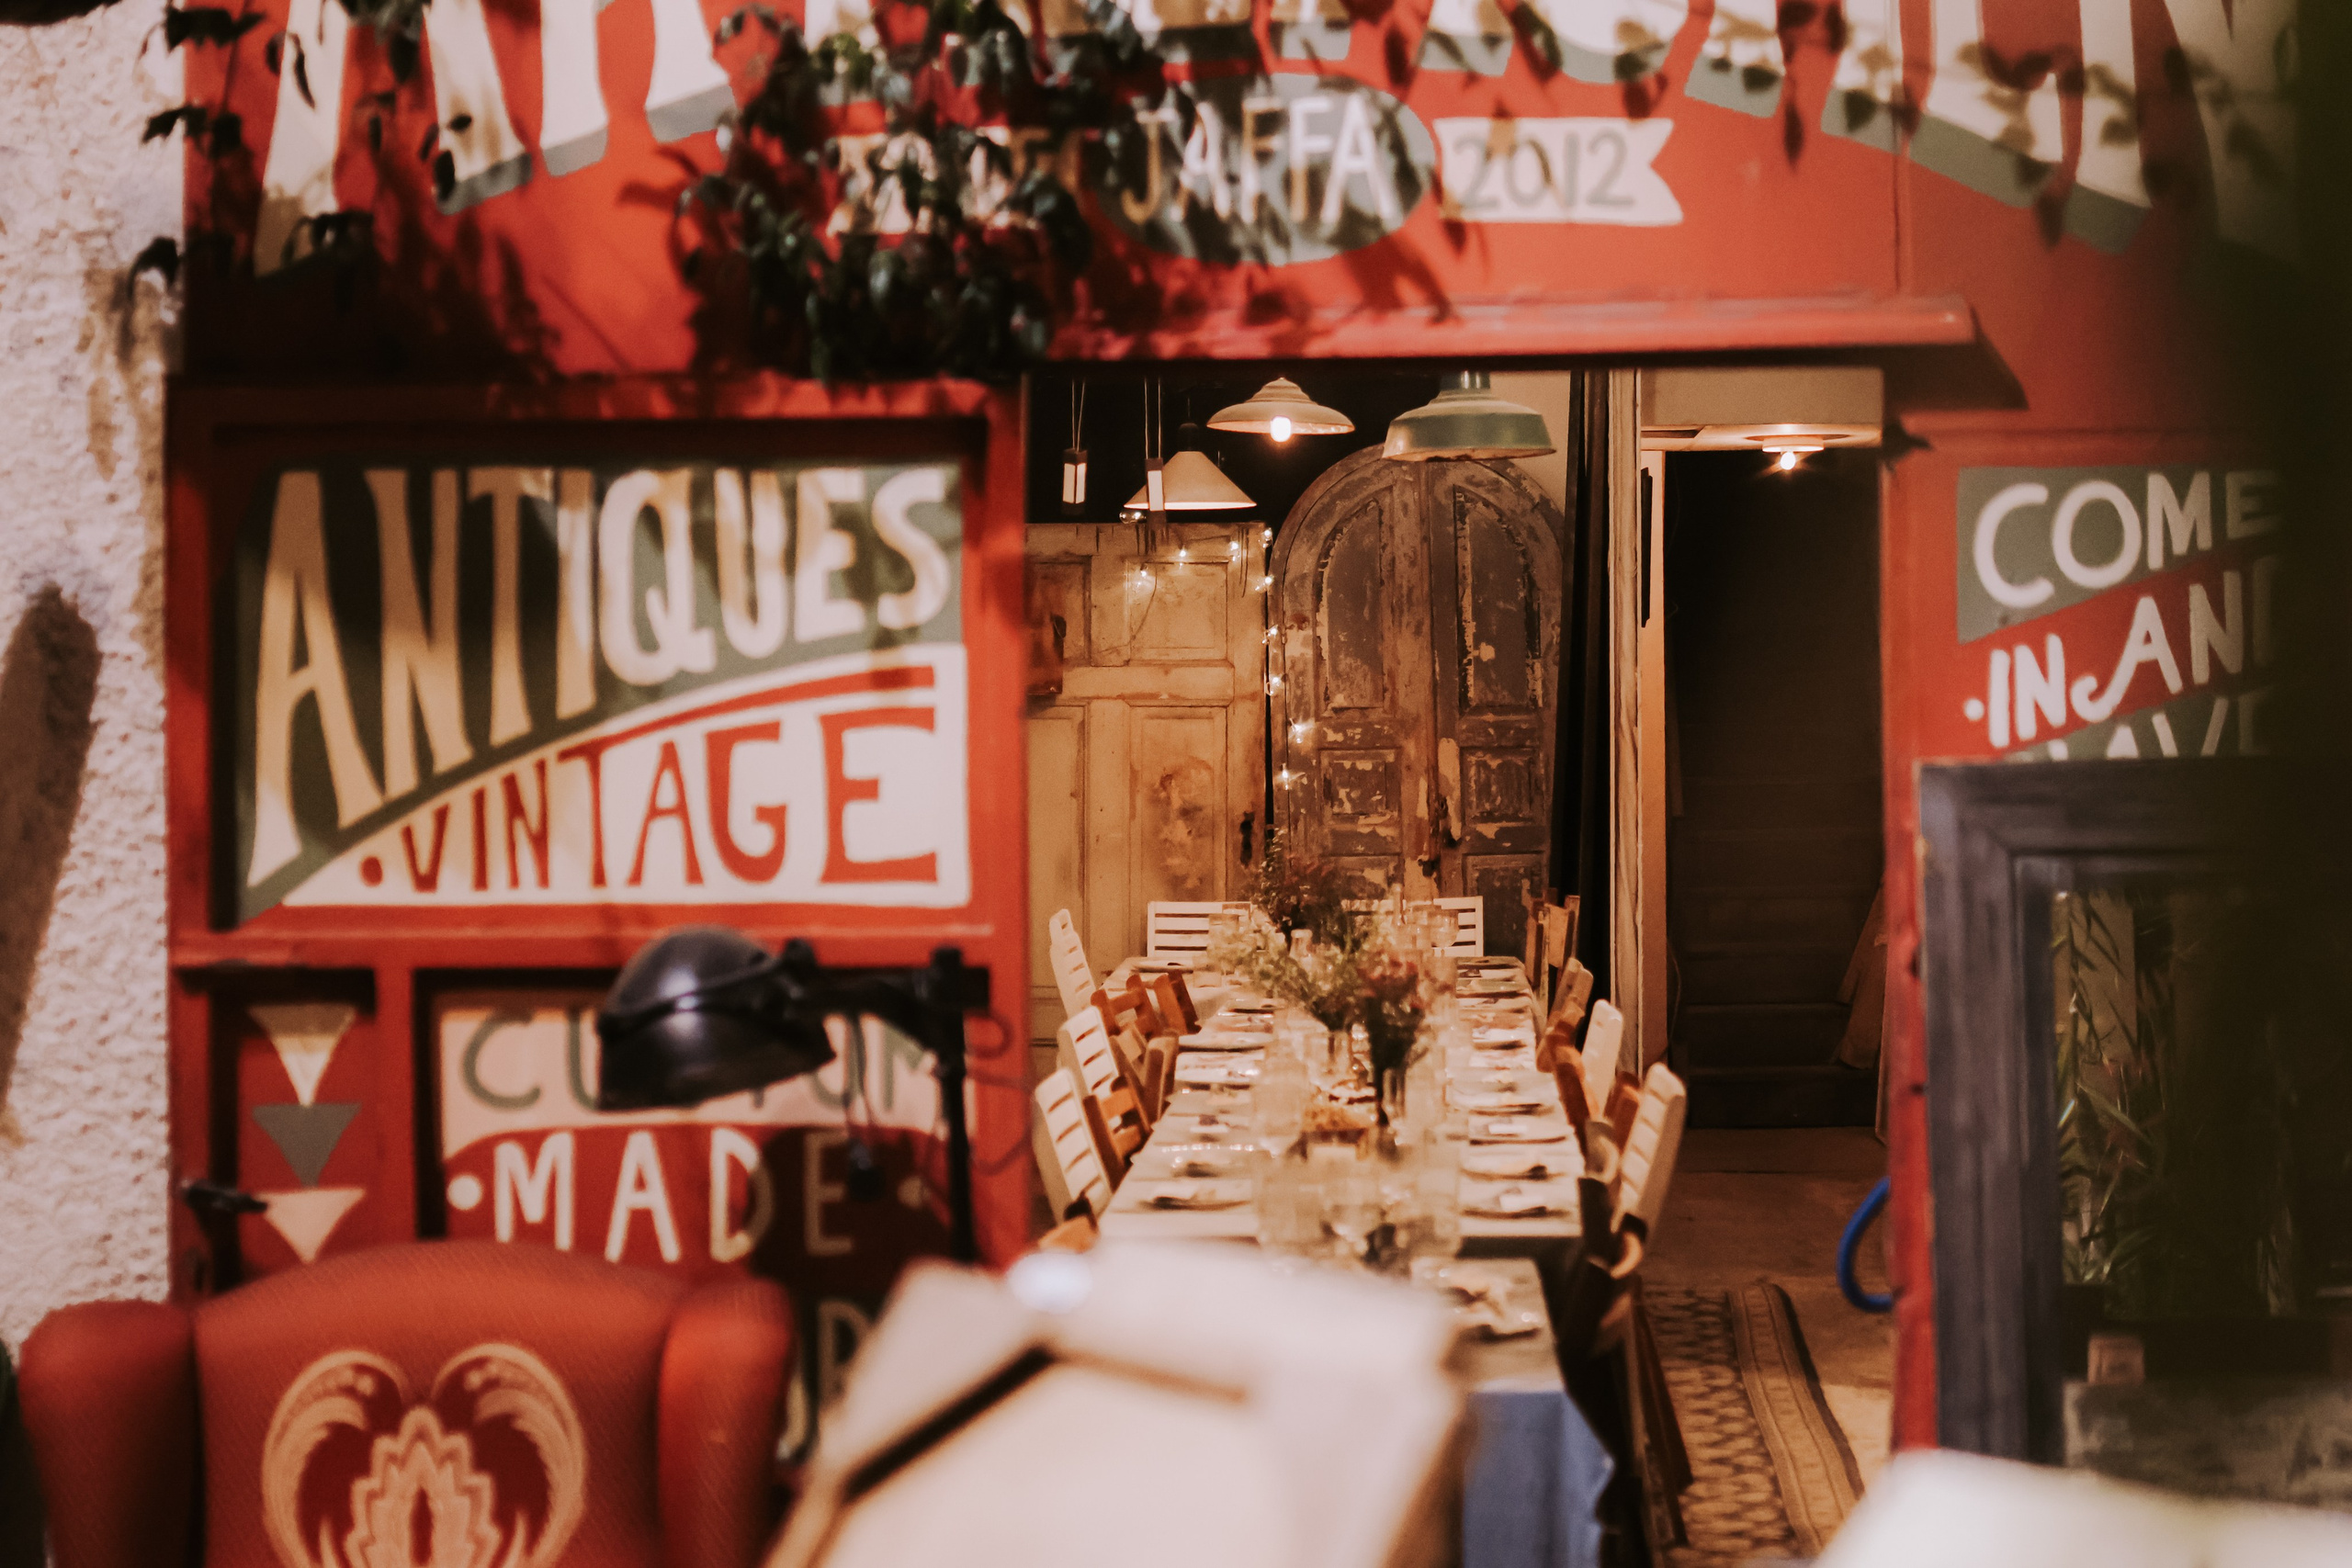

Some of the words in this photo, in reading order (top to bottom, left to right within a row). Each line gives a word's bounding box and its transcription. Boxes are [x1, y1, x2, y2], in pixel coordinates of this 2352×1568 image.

[1120, 93, 1401, 225] JAFFA
[1453, 130, 1635, 209] 2012
[1973, 469, 2281, 608] COME
[247, 465, 952, 888] ANTIQUES
[1988, 633, 2067, 749] IN
[401, 702, 939, 894] VINTAGE
[493, 1129, 854, 1262] MADE
